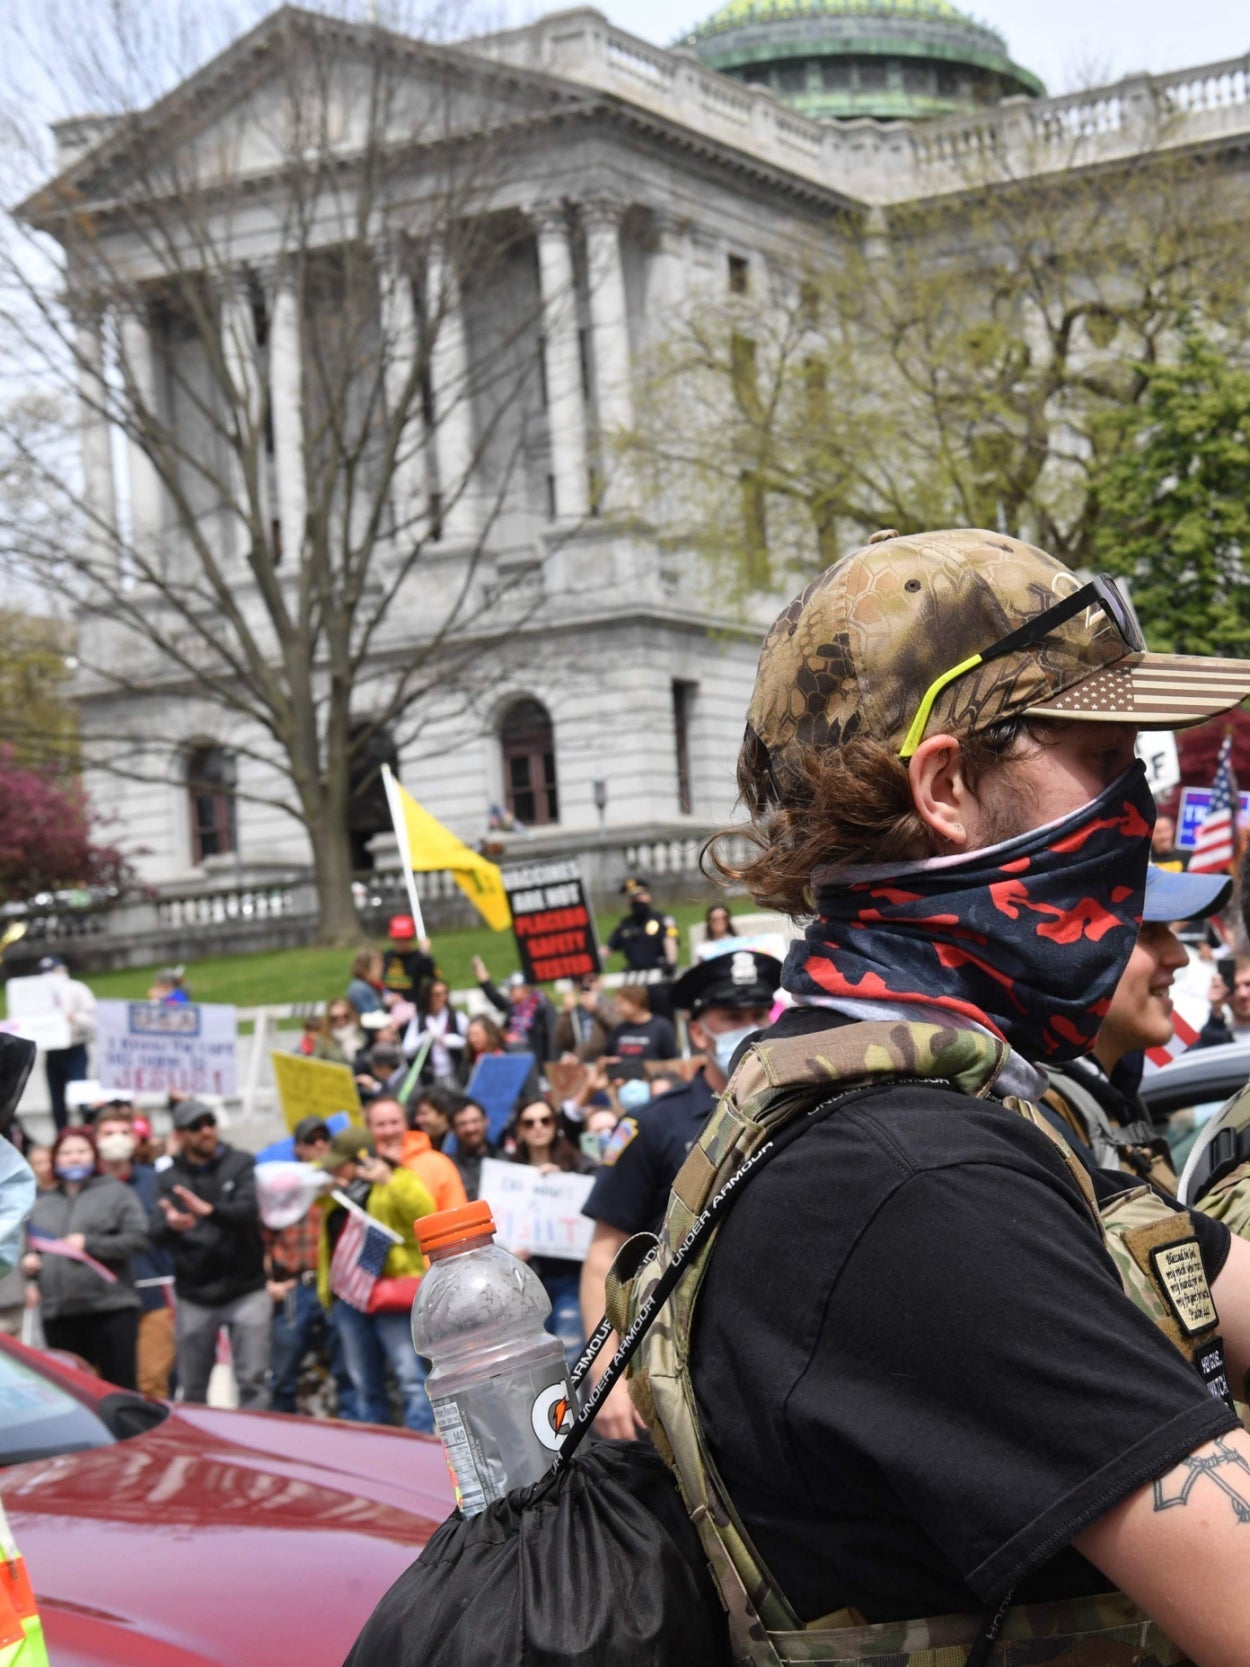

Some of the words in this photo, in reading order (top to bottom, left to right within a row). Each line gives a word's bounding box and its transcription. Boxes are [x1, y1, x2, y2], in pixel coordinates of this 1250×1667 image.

[671, 1209, 711, 1267] UNDER
[712, 1141, 774, 1209] ARMOUR
[577, 1366, 614, 1424] UNDER
[612, 1295, 656, 1368] ARMOUR
